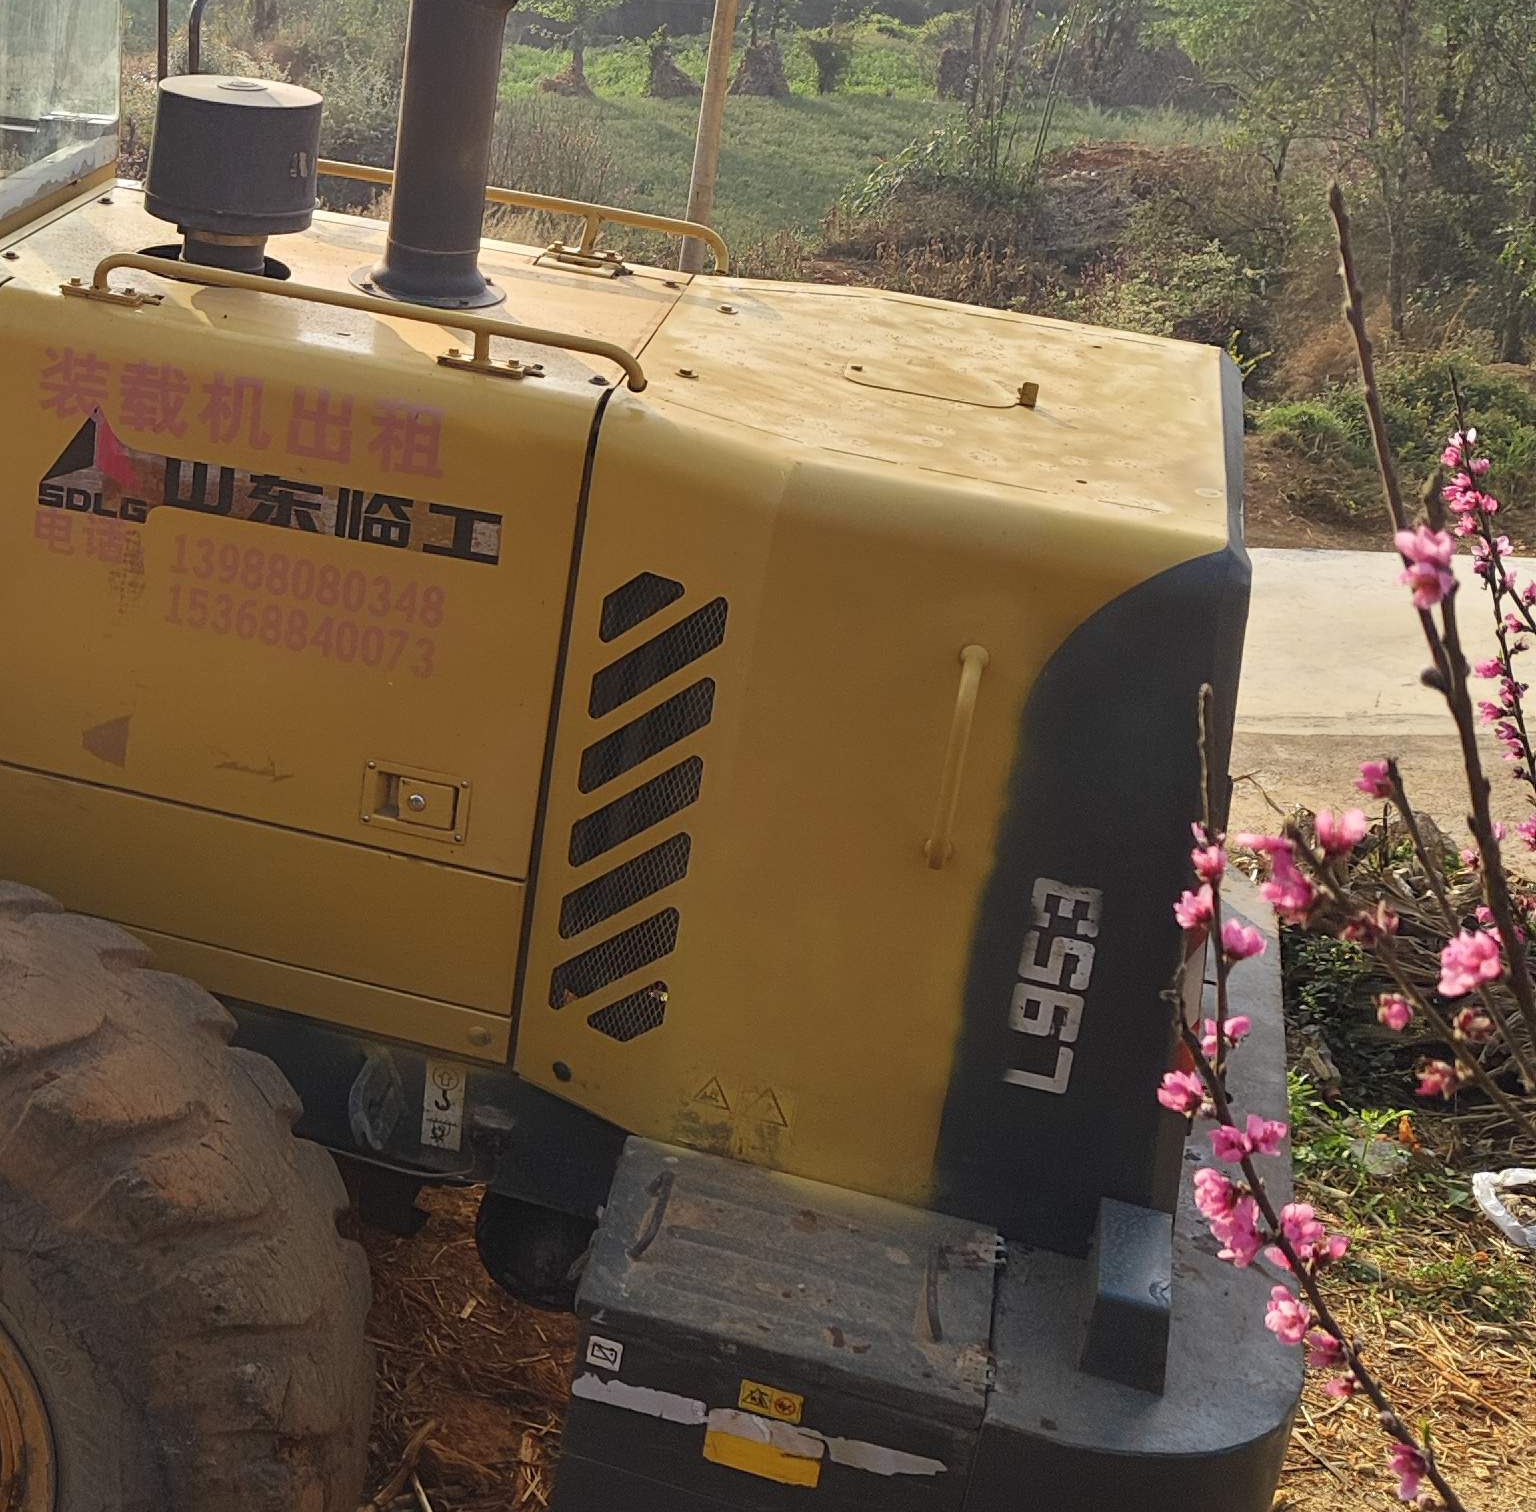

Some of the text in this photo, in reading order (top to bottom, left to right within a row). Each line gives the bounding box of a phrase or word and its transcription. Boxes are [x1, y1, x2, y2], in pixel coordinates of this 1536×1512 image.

[39, 347, 445, 479] 装载机出租
[38, 481, 149, 524] SDLG
[164, 456, 503, 566] 山东临工
[165, 582, 437, 680] 15368840073
[169, 533, 446, 628] 13988080348
[1002, 877, 1104, 1094] L953
